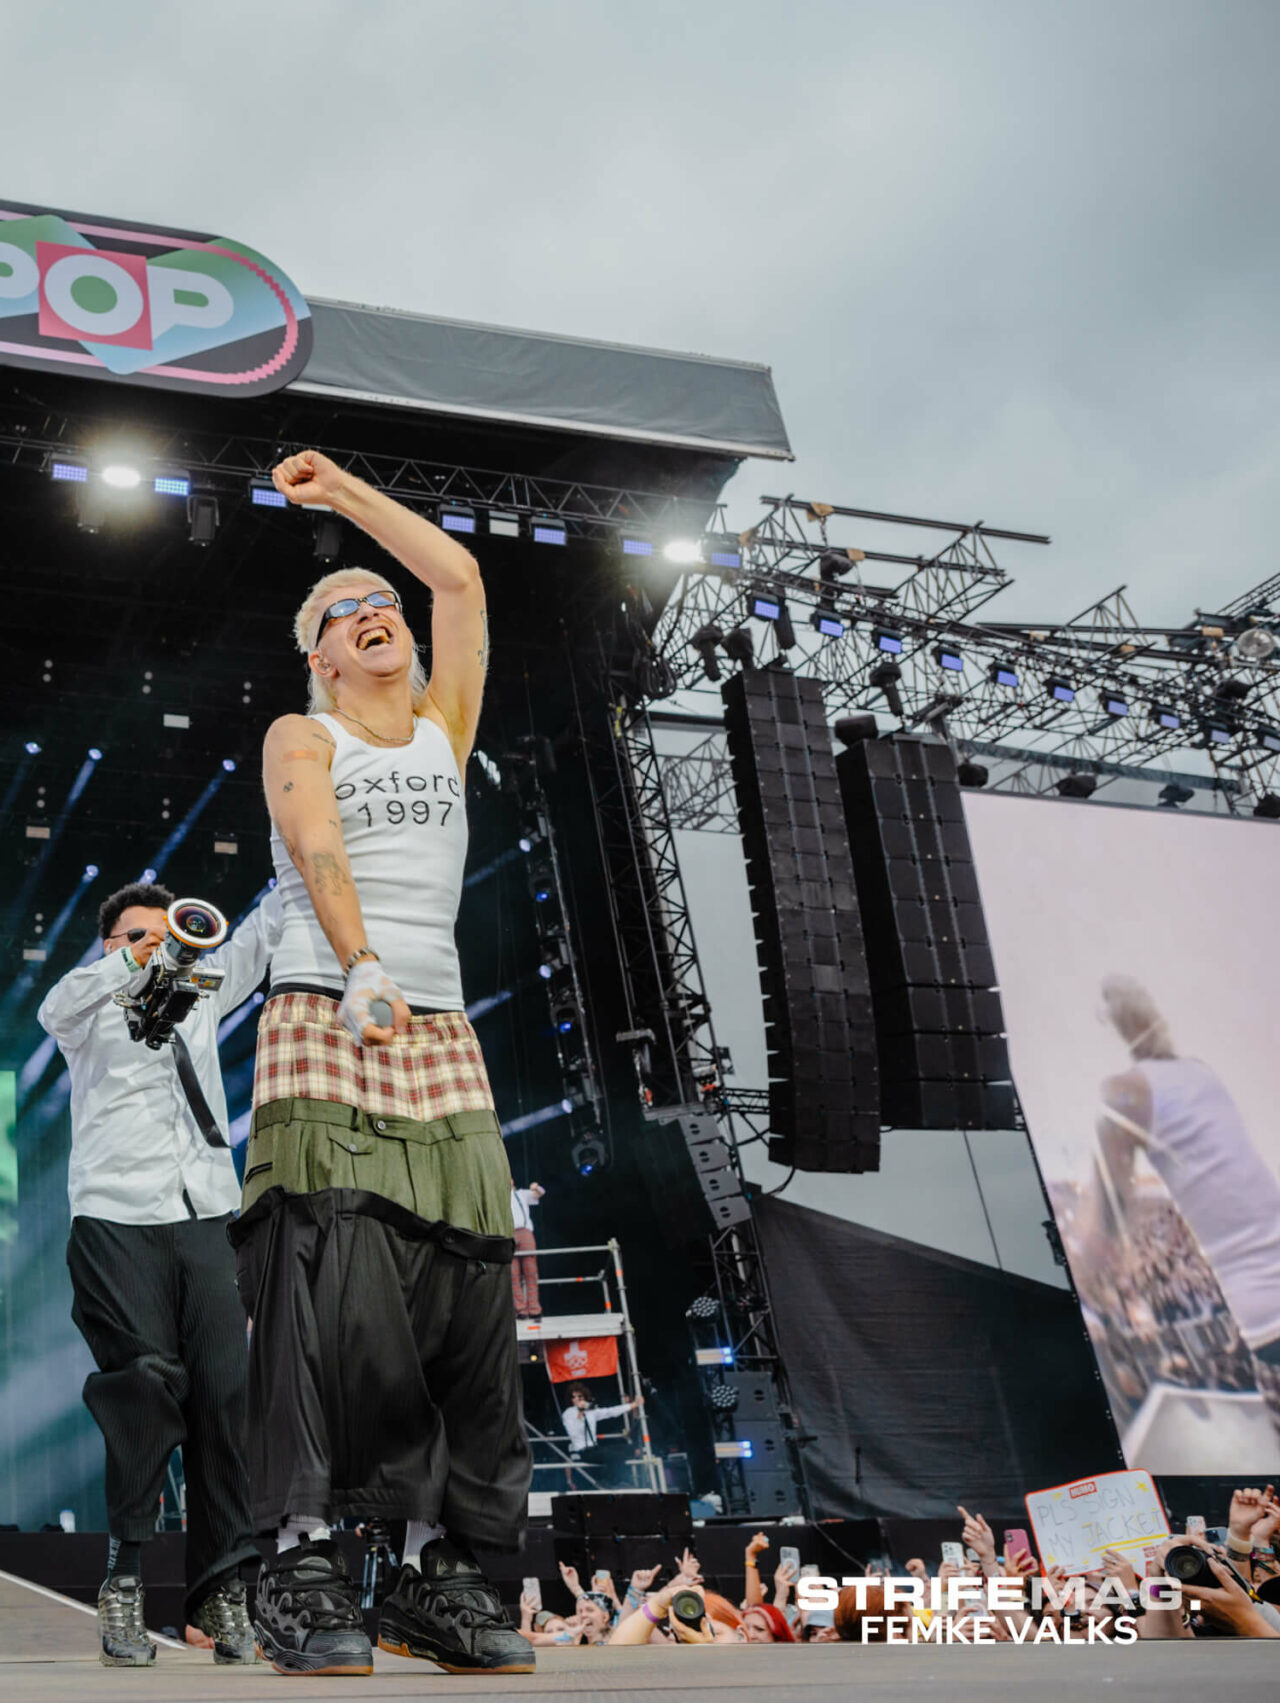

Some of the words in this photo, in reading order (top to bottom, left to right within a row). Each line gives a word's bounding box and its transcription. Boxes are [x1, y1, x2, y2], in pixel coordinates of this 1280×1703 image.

[358, 800, 453, 827] 1997
[1037, 1499, 1078, 1527] PLS
[1084, 1484, 1136, 1515] SIGN
[1048, 1532, 1074, 1558] MY
[1081, 1509, 1164, 1548] JACKET
